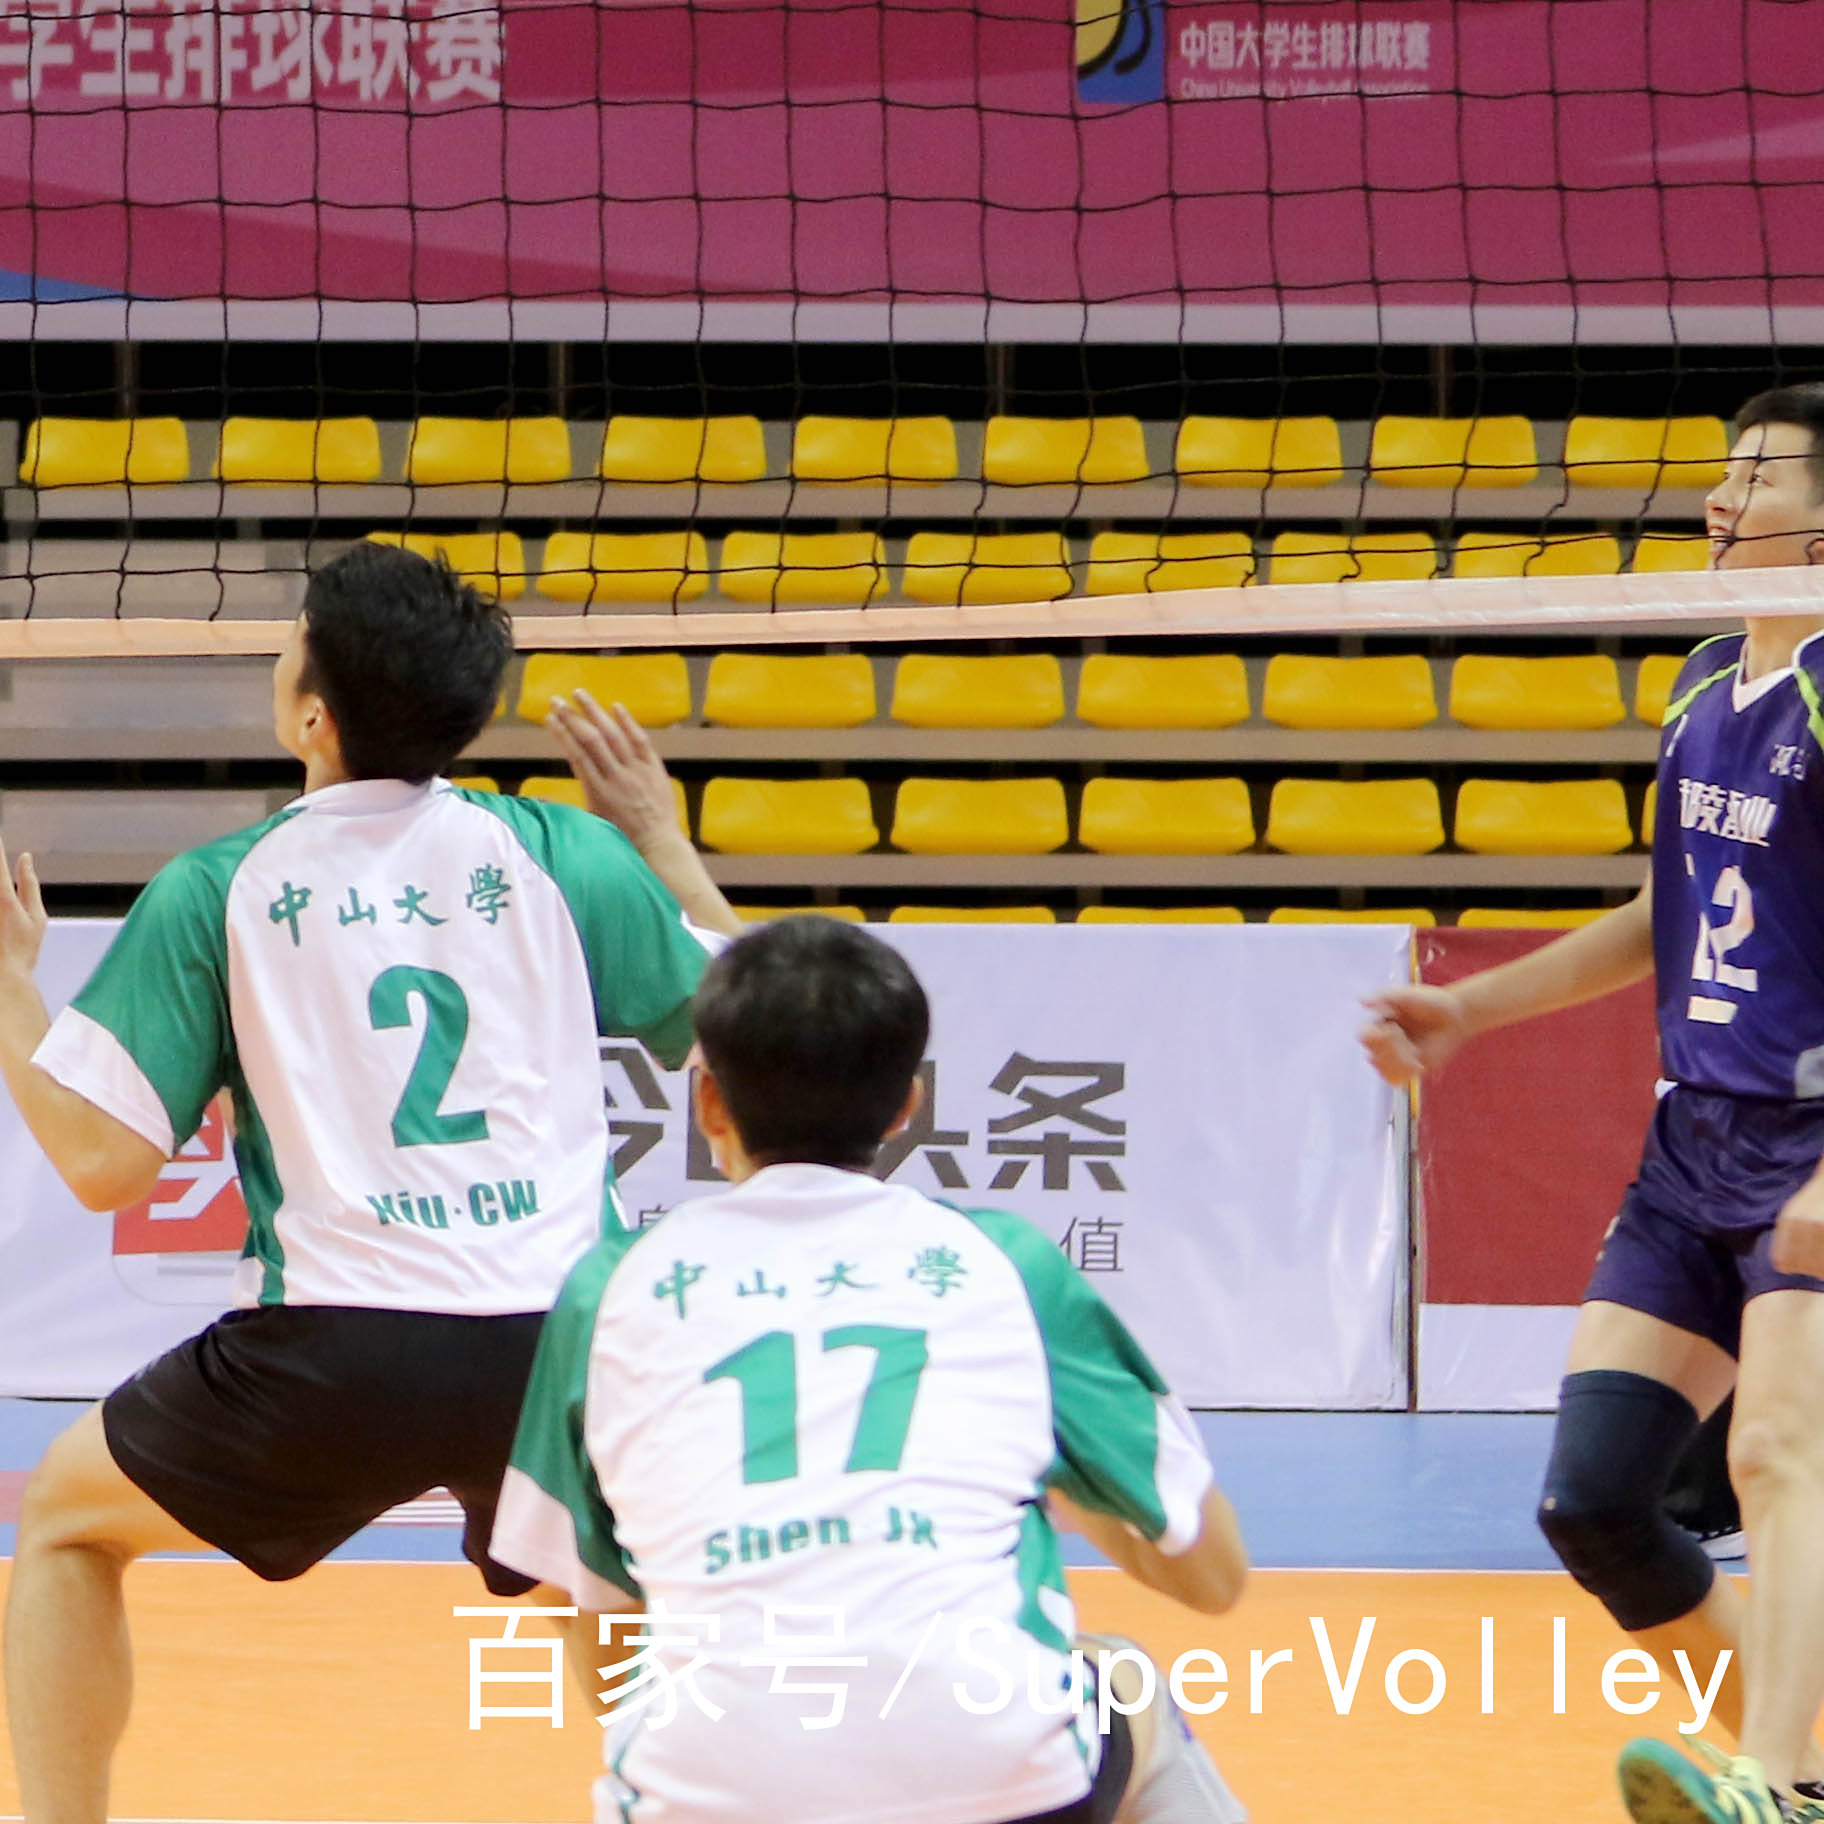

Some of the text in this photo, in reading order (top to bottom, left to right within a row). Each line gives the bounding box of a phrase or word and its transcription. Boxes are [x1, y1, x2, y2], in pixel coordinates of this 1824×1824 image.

[1180, 21, 1431, 70] 中国大学生排球联赛
[368, 963, 490, 1147] 2
[702, 1324, 933, 1485] 17
